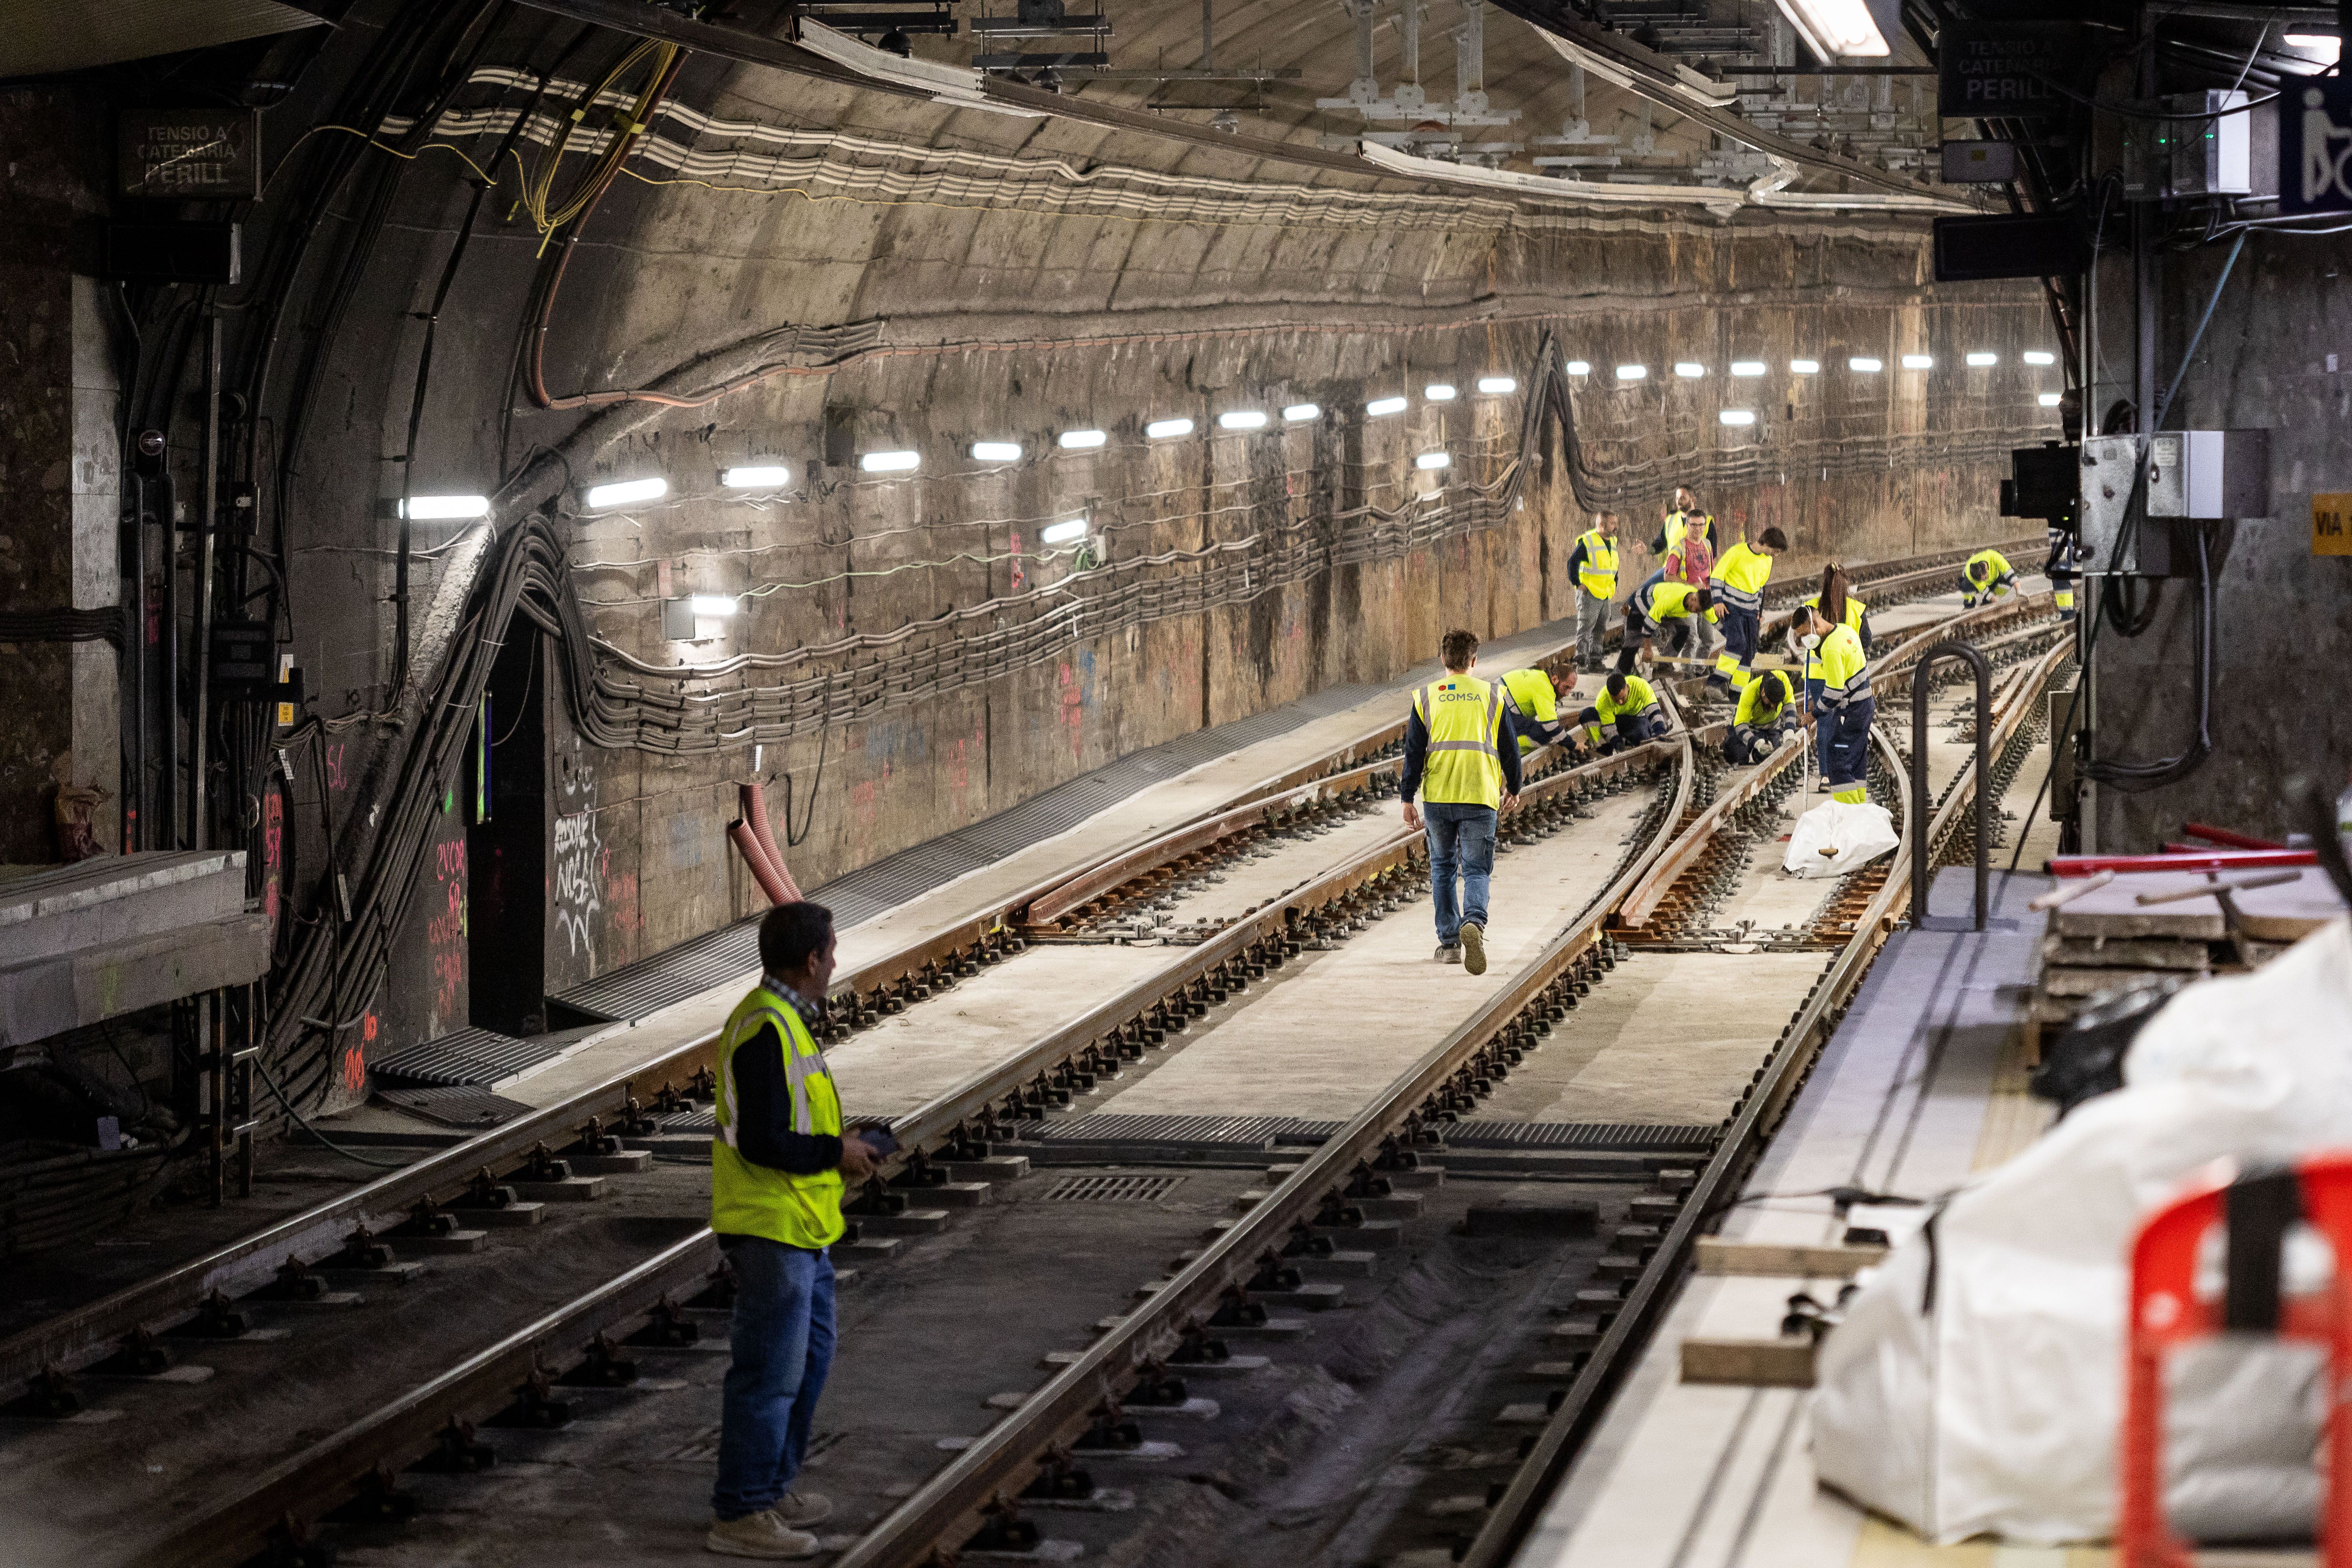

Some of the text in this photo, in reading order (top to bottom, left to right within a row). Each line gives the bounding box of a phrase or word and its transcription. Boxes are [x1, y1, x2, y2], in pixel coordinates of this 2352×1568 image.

[1966, 78, 2056, 100] PERILL
[215, 126, 226, 140] A
[145, 162, 230, 183] PERILL
[2315, 511, 2343, 536] VIA
[1438, 693, 1482, 702] COMSA
